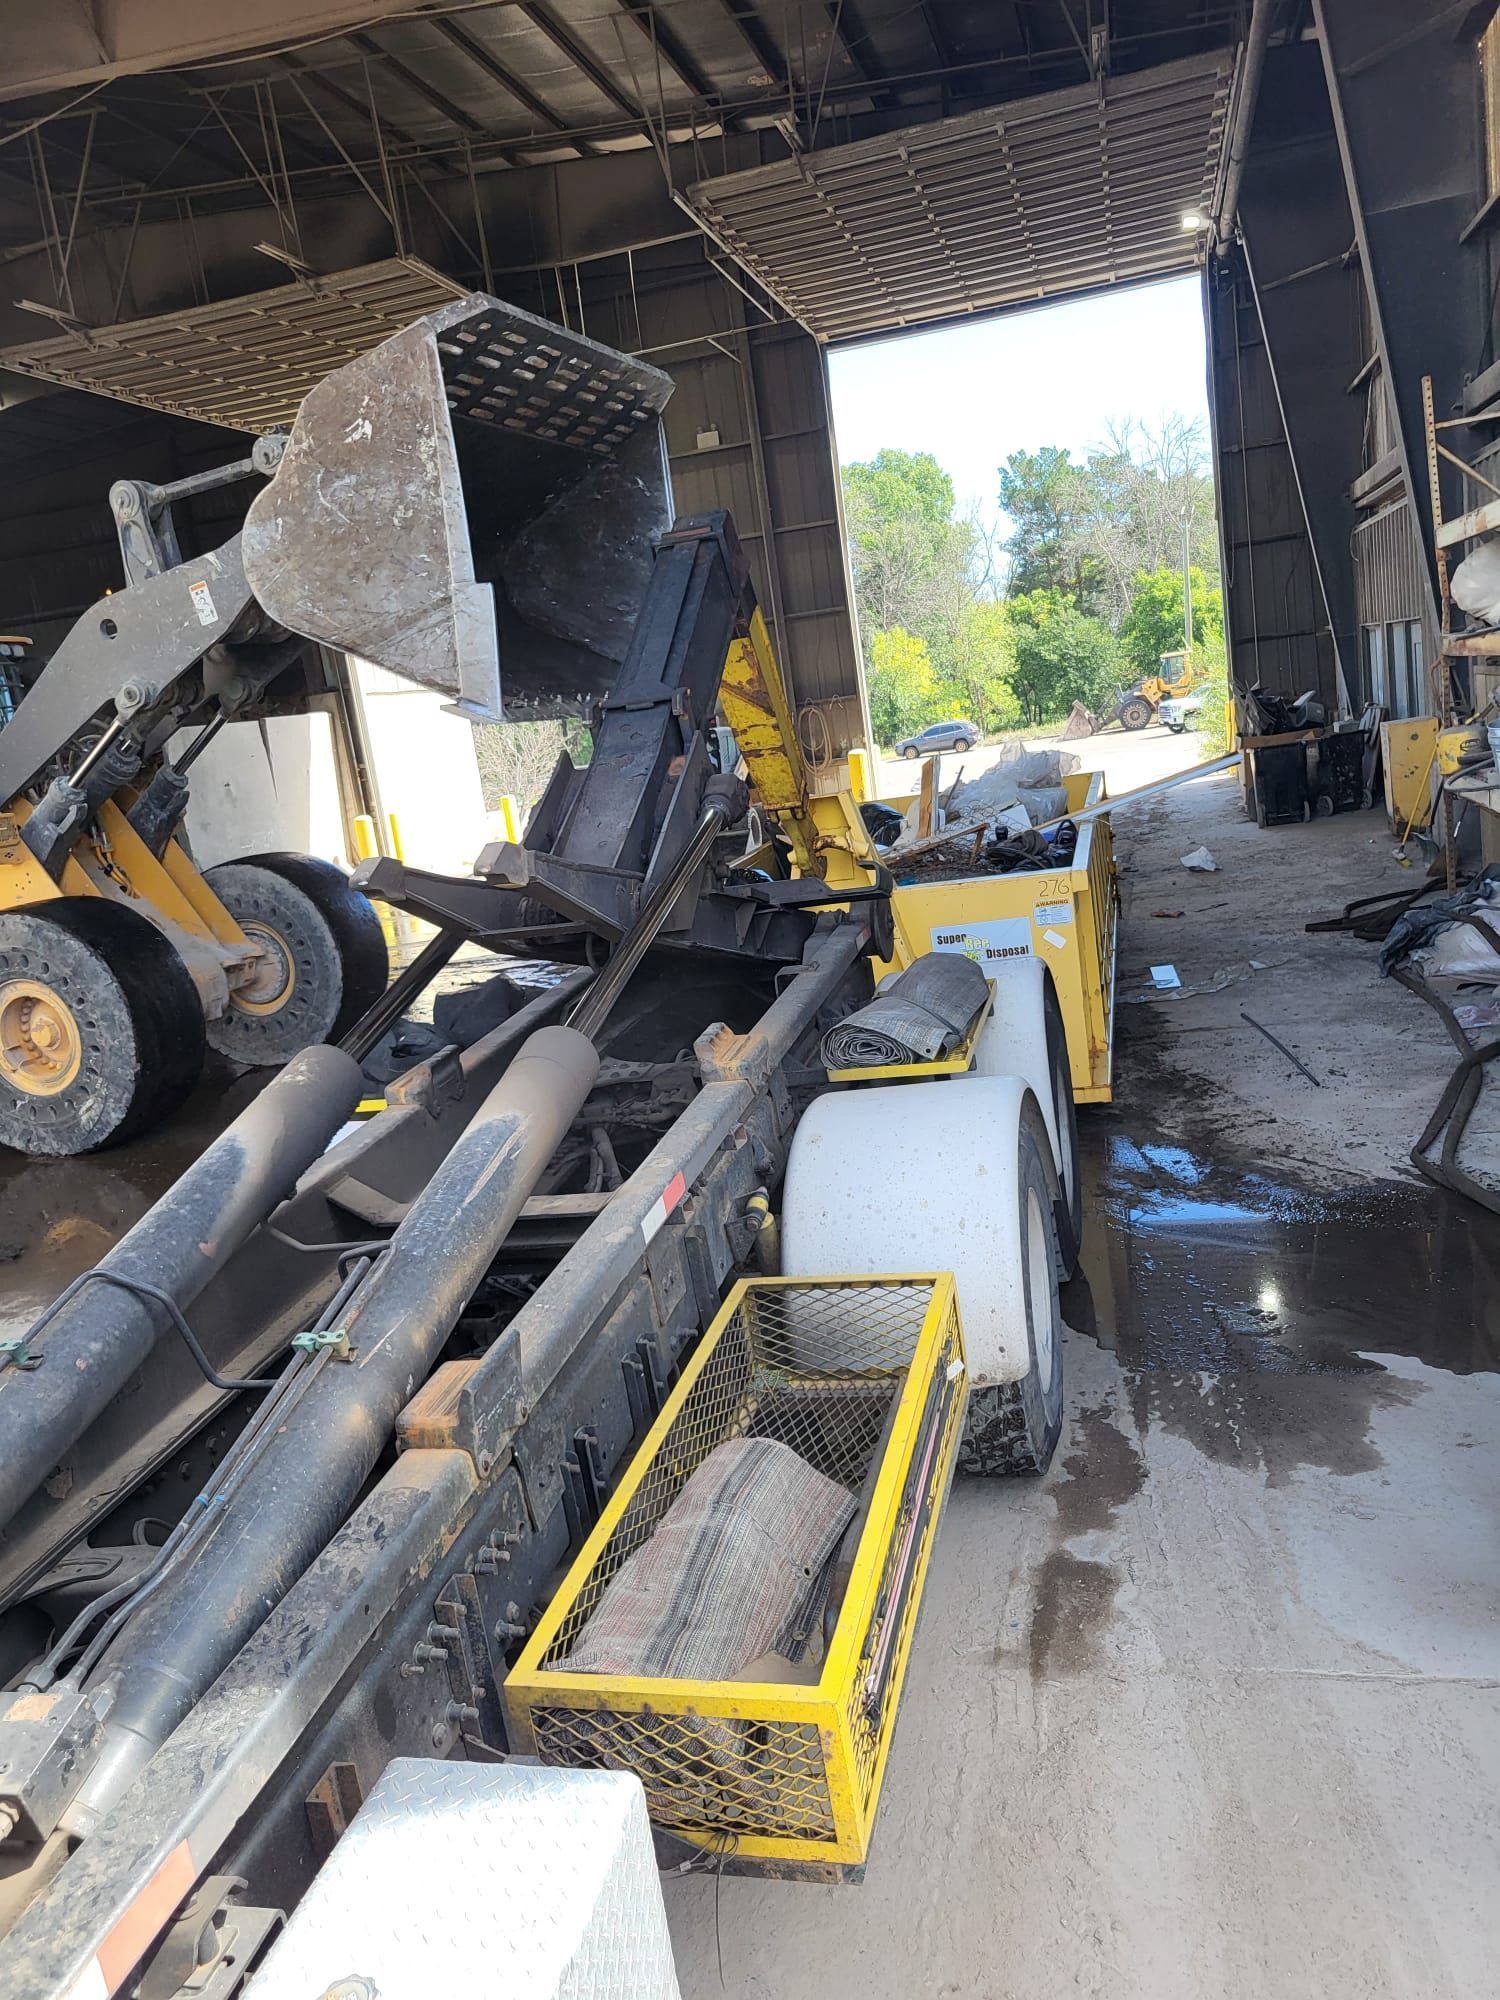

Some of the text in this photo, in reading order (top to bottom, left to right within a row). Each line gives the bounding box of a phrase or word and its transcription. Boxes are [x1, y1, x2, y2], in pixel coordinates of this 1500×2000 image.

[1038, 878, 1069, 897] 276
[1040, 899, 1069, 907] WARNING
[936, 934, 966, 945] Super
[964, 938, 990, 950] Bee
[986, 945, 1029, 959] Disposal
